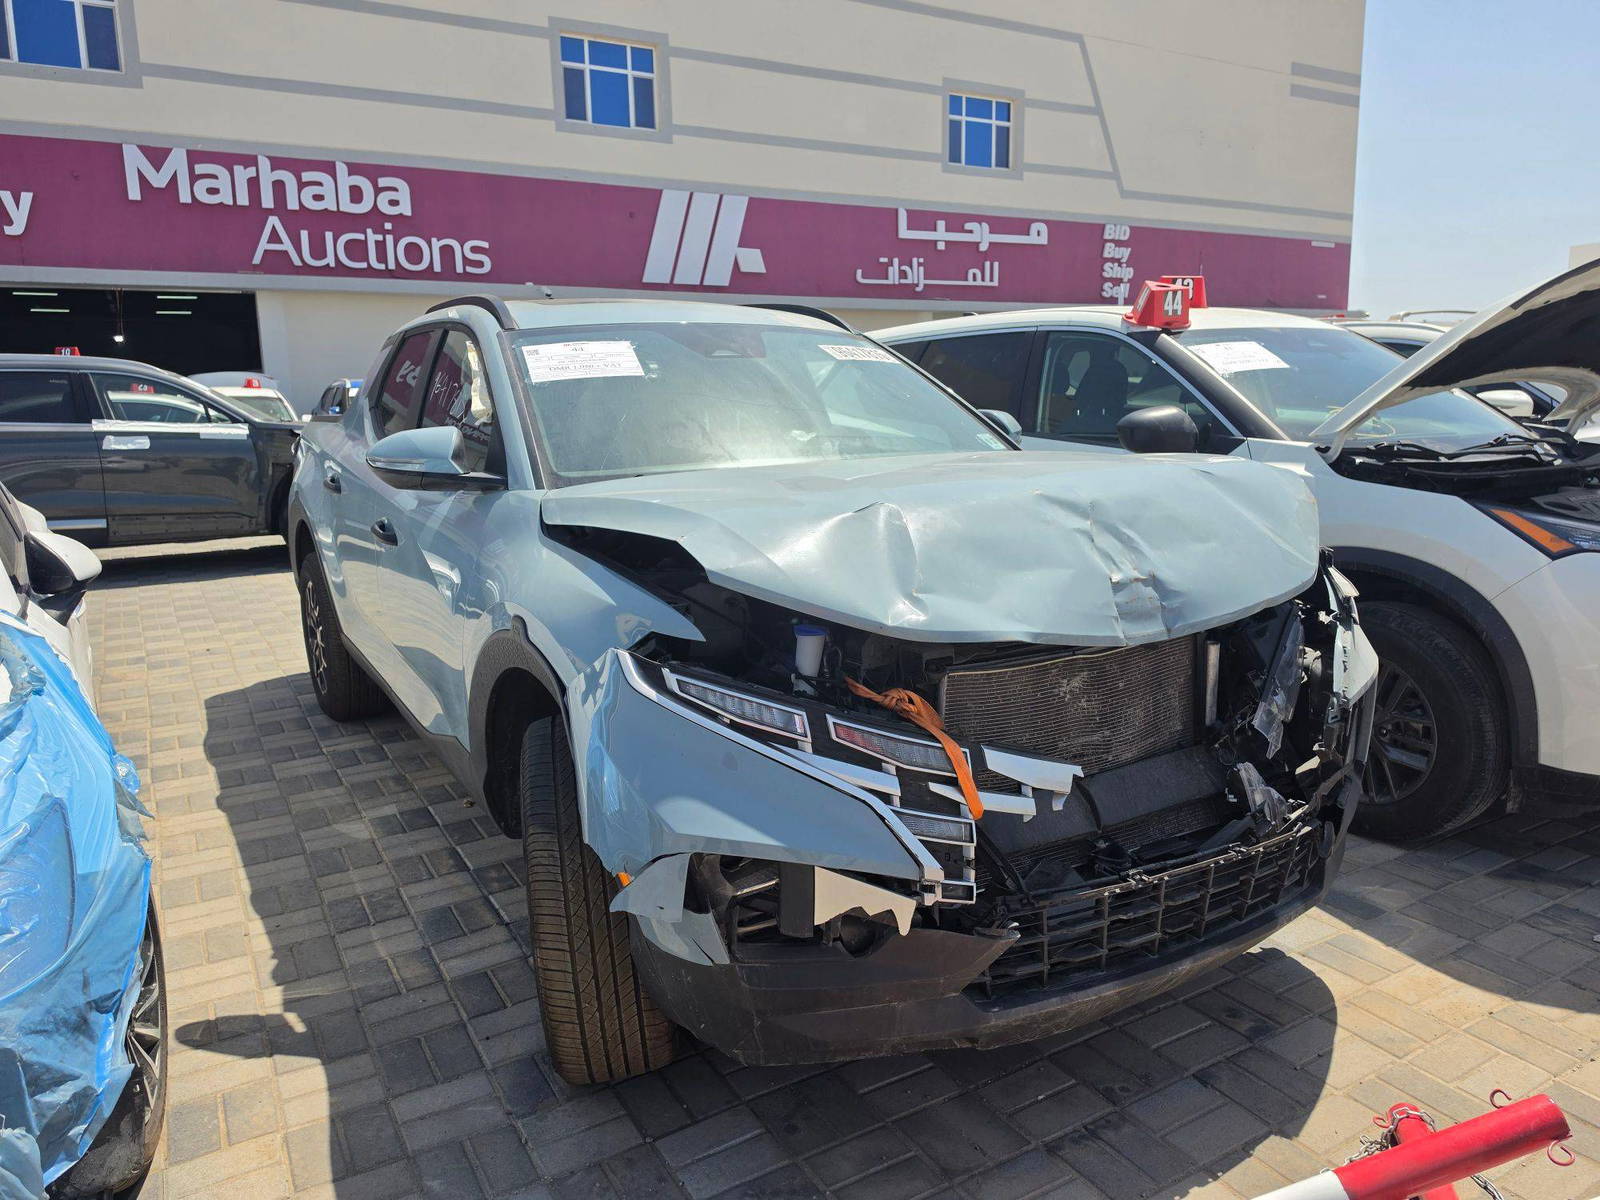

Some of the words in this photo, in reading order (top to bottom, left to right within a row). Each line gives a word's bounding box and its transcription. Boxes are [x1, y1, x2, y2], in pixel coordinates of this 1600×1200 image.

[122, 143, 412, 217] Marhaba
[252, 215, 492, 275] Auctions
[898, 208, 1048, 252] مرحبا
[1103, 224, 1131, 240] BID
[1102, 242, 1132, 262] Buy
[856, 257, 999, 292] للمزادات
[1102, 262, 1134, 282] Ship
[1163, 290, 1183, 316] 44
